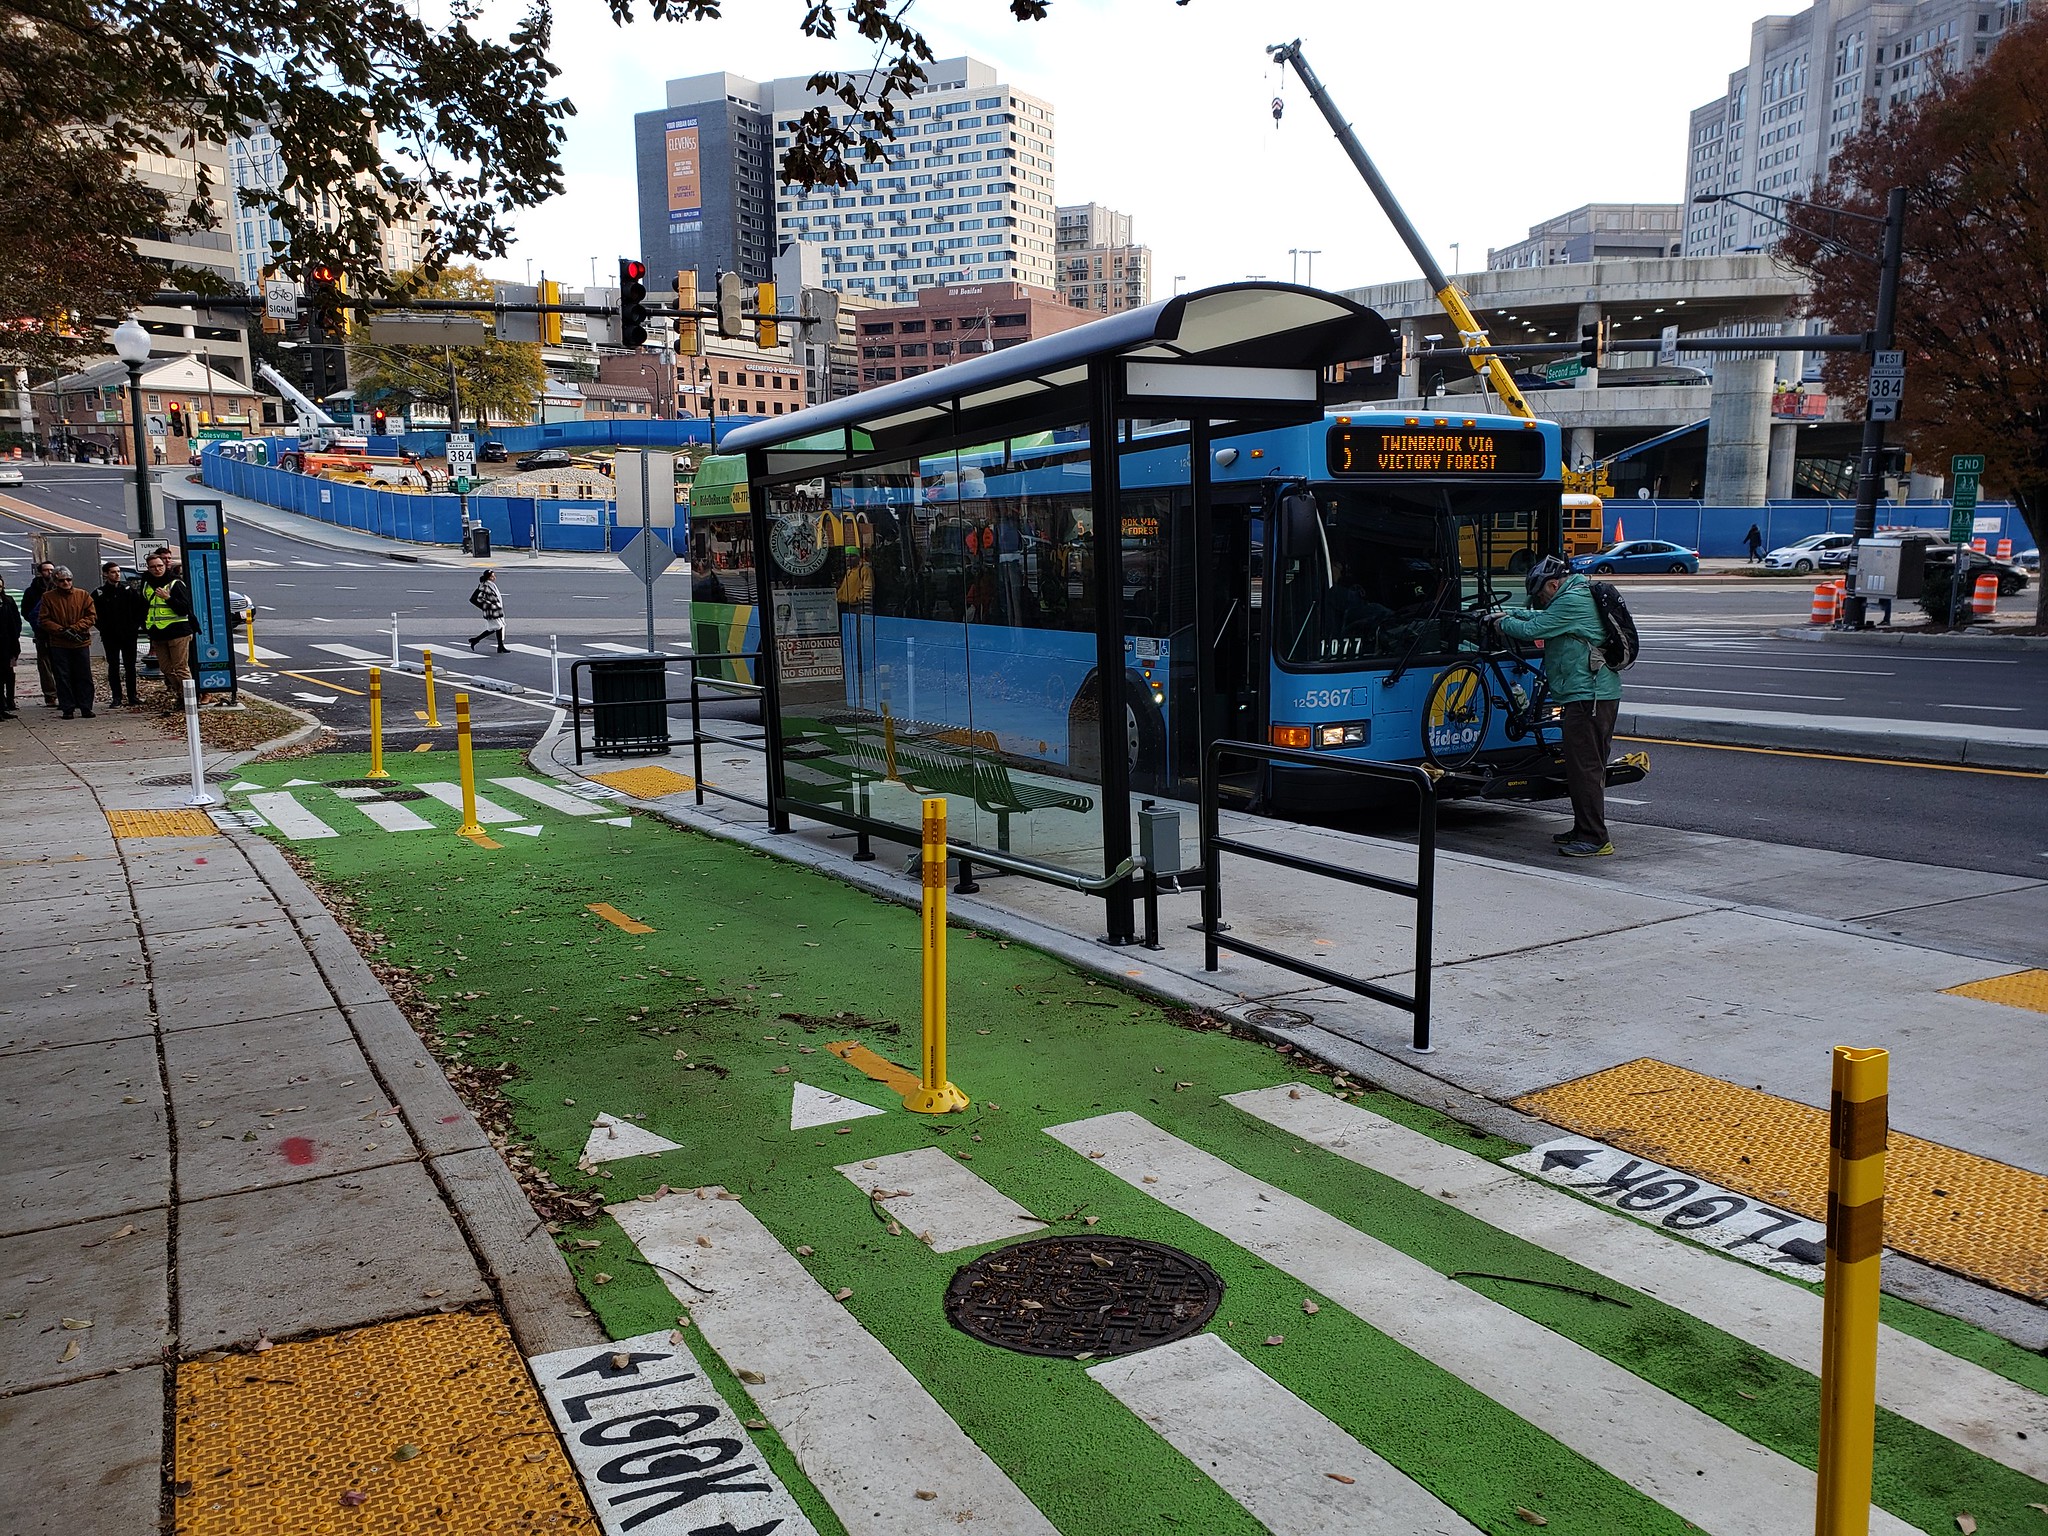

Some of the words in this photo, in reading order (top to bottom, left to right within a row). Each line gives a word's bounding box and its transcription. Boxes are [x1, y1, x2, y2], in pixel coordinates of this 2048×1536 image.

[960, 287, 983, 295] Bonifant
[269, 304, 294, 314] SIGNAL
[1879, 354, 1899, 363] WEST
[746, 364, 773, 372] GREENBERG
[779, 367, 802, 375] BEDERMAN
[1549, 366, 1568, 379] Second
[1871, 379, 1901, 397] 384
[1381, 435, 1462, 451] TWINBROOK
[1469, 436, 1494, 452] VIA
[450, 450, 473, 462] 384
[1378, 454, 1441, 469] VICTORY
[1447, 454, 1497, 470] FOREST
[1957, 459, 1979, 470] END
[1140, 517, 1158, 526] VIA
[1128, 526, 1159, 535] FOREST
[211, 542, 220, 550] 17
[781, 559, 822, 574] MARYLAND
[780, 640, 794, 650] NO
[796, 639, 840, 649] SMOKING
[782, 669, 795, 678] NO
[798, 666, 841, 676] SMOKING
[1566, 1160, 1802, 1250] LOOK
[561, 1372, 773, 1532] LOOK
